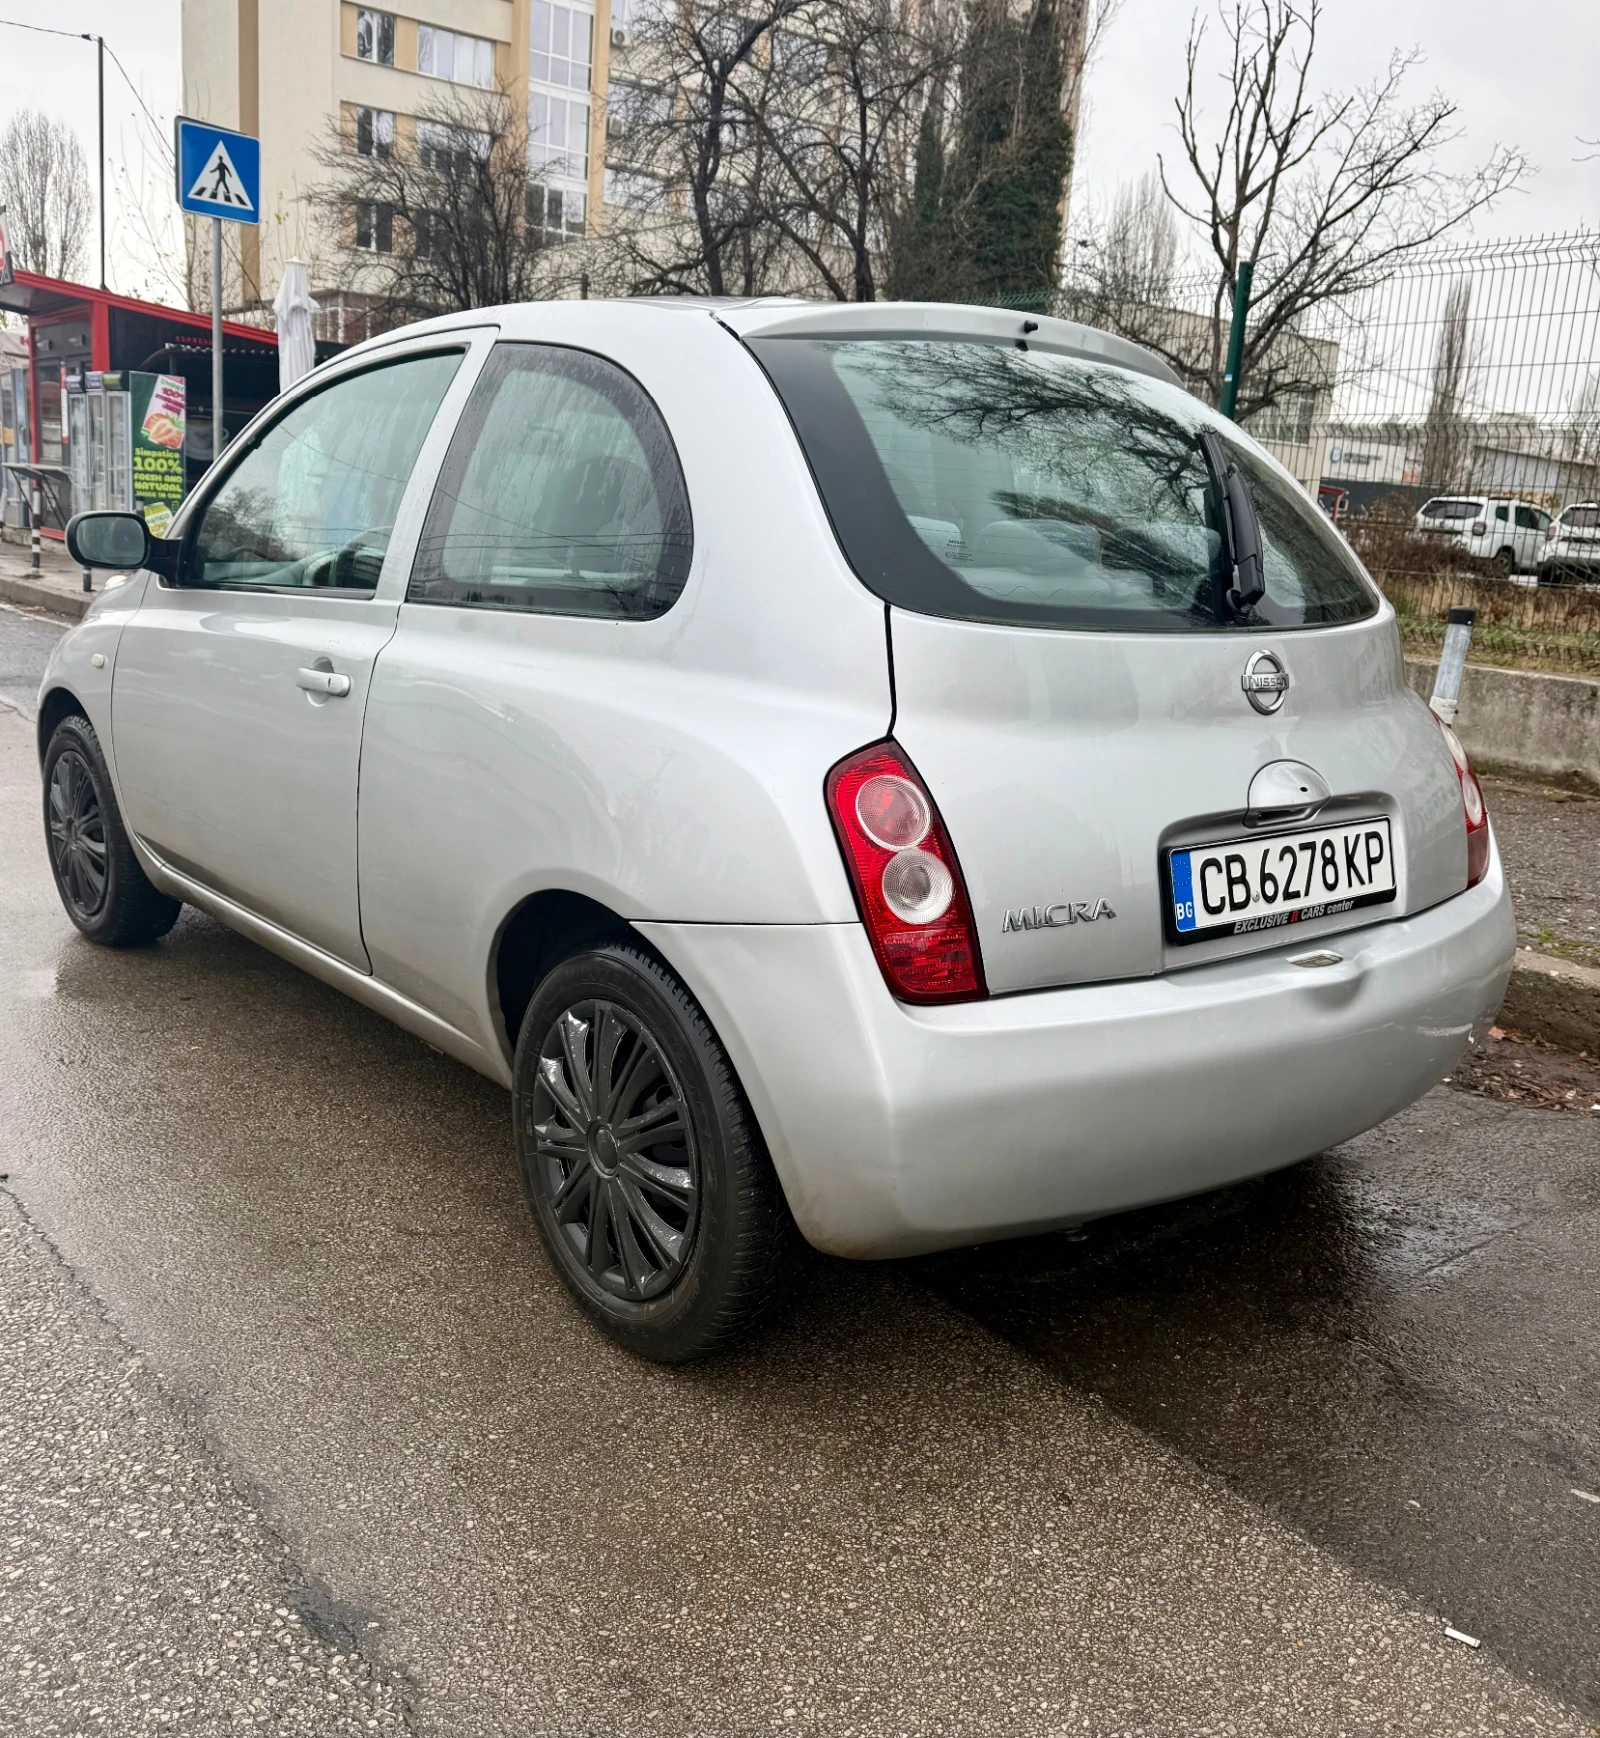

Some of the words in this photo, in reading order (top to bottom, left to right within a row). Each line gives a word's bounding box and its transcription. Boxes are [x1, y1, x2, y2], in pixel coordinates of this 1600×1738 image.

[134, 447, 180, 458] Simpatico
[133, 456, 182, 474] 100%
[134, 473, 162, 482] FRESH
[164, 475, 183, 483] AND
[134, 481, 182, 492] NATURAL
[1250, 676, 1288, 688] NISSAN
[1200, 853, 1250, 915] CB
[1259, 838, 1339, 904] 6278
[1344, 831, 1384, 888] KP
[1002, 897, 1117, 933] MICRA
[1176, 902, 1193, 920] BG
[1233, 912, 1289, 934] EXCLUSIVE
[1300, 906, 1325, 920] CARS
[1326, 899, 1354, 914] center
